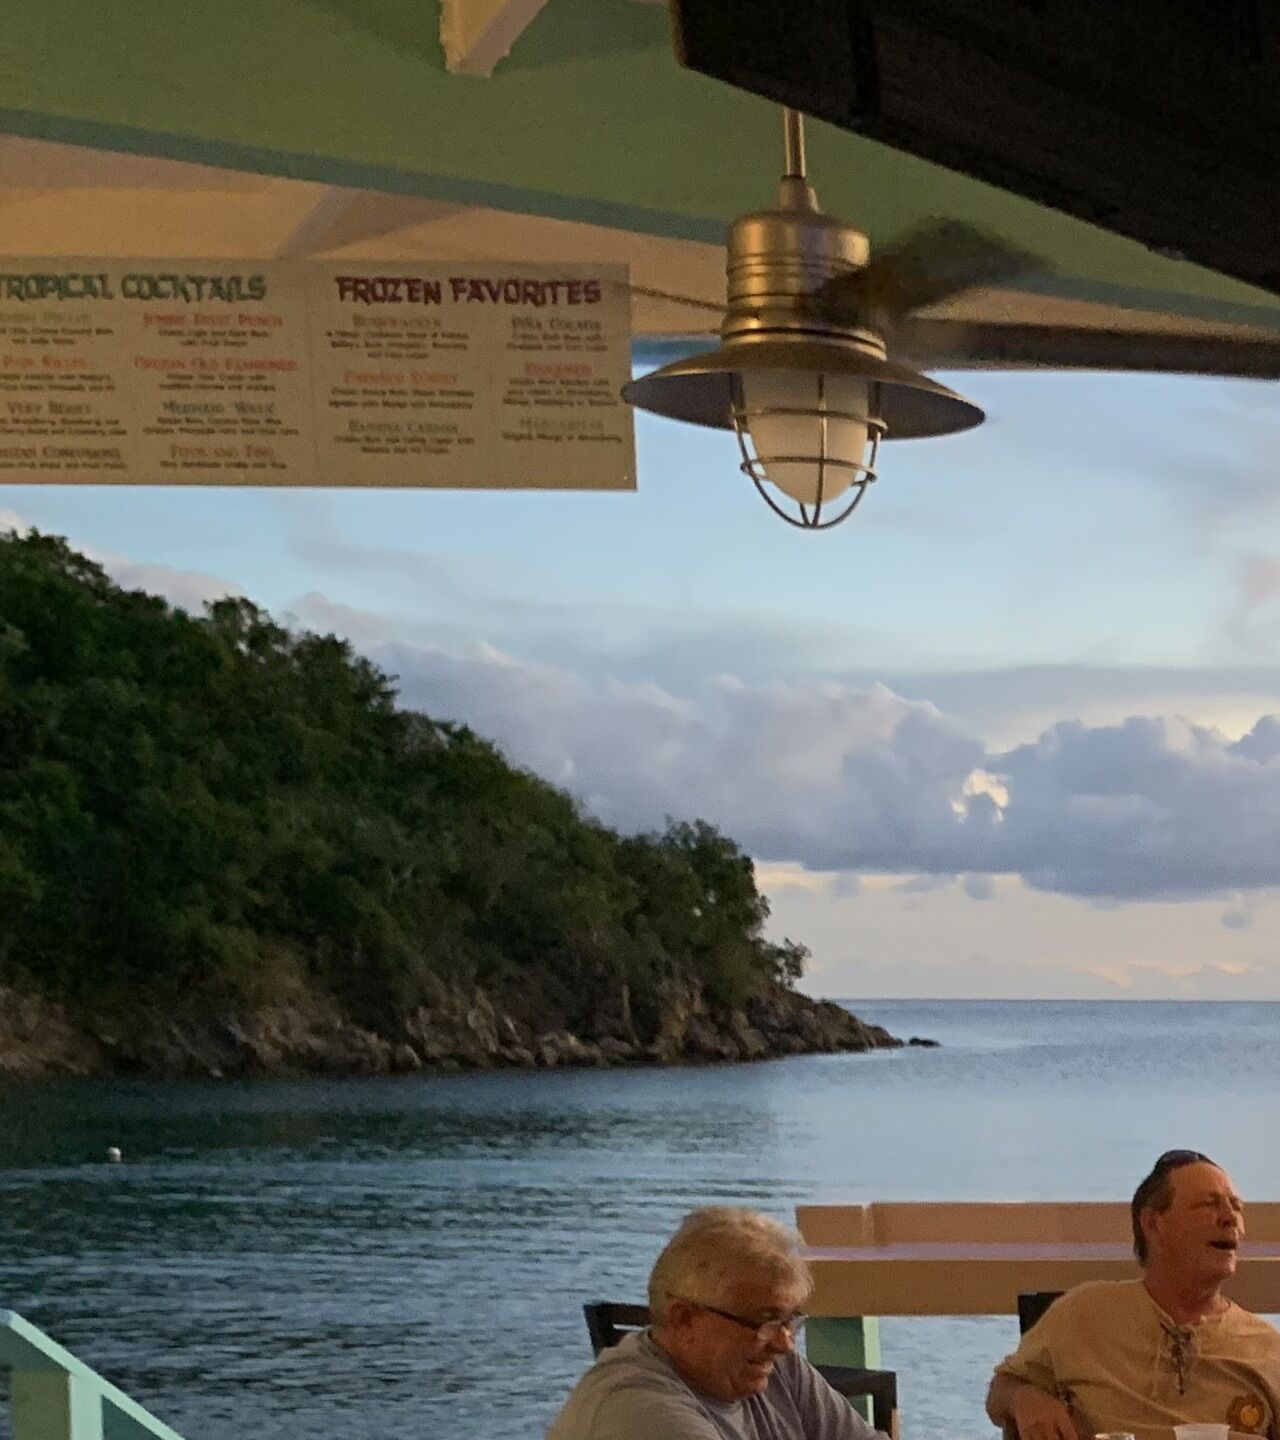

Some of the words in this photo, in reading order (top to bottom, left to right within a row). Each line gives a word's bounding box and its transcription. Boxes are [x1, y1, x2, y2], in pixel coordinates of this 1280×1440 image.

[121, 274, 267, 302] COCKTAILS
[335, 276, 442, 305] FROZEN
[449, 278, 600, 307] FAVORITES
